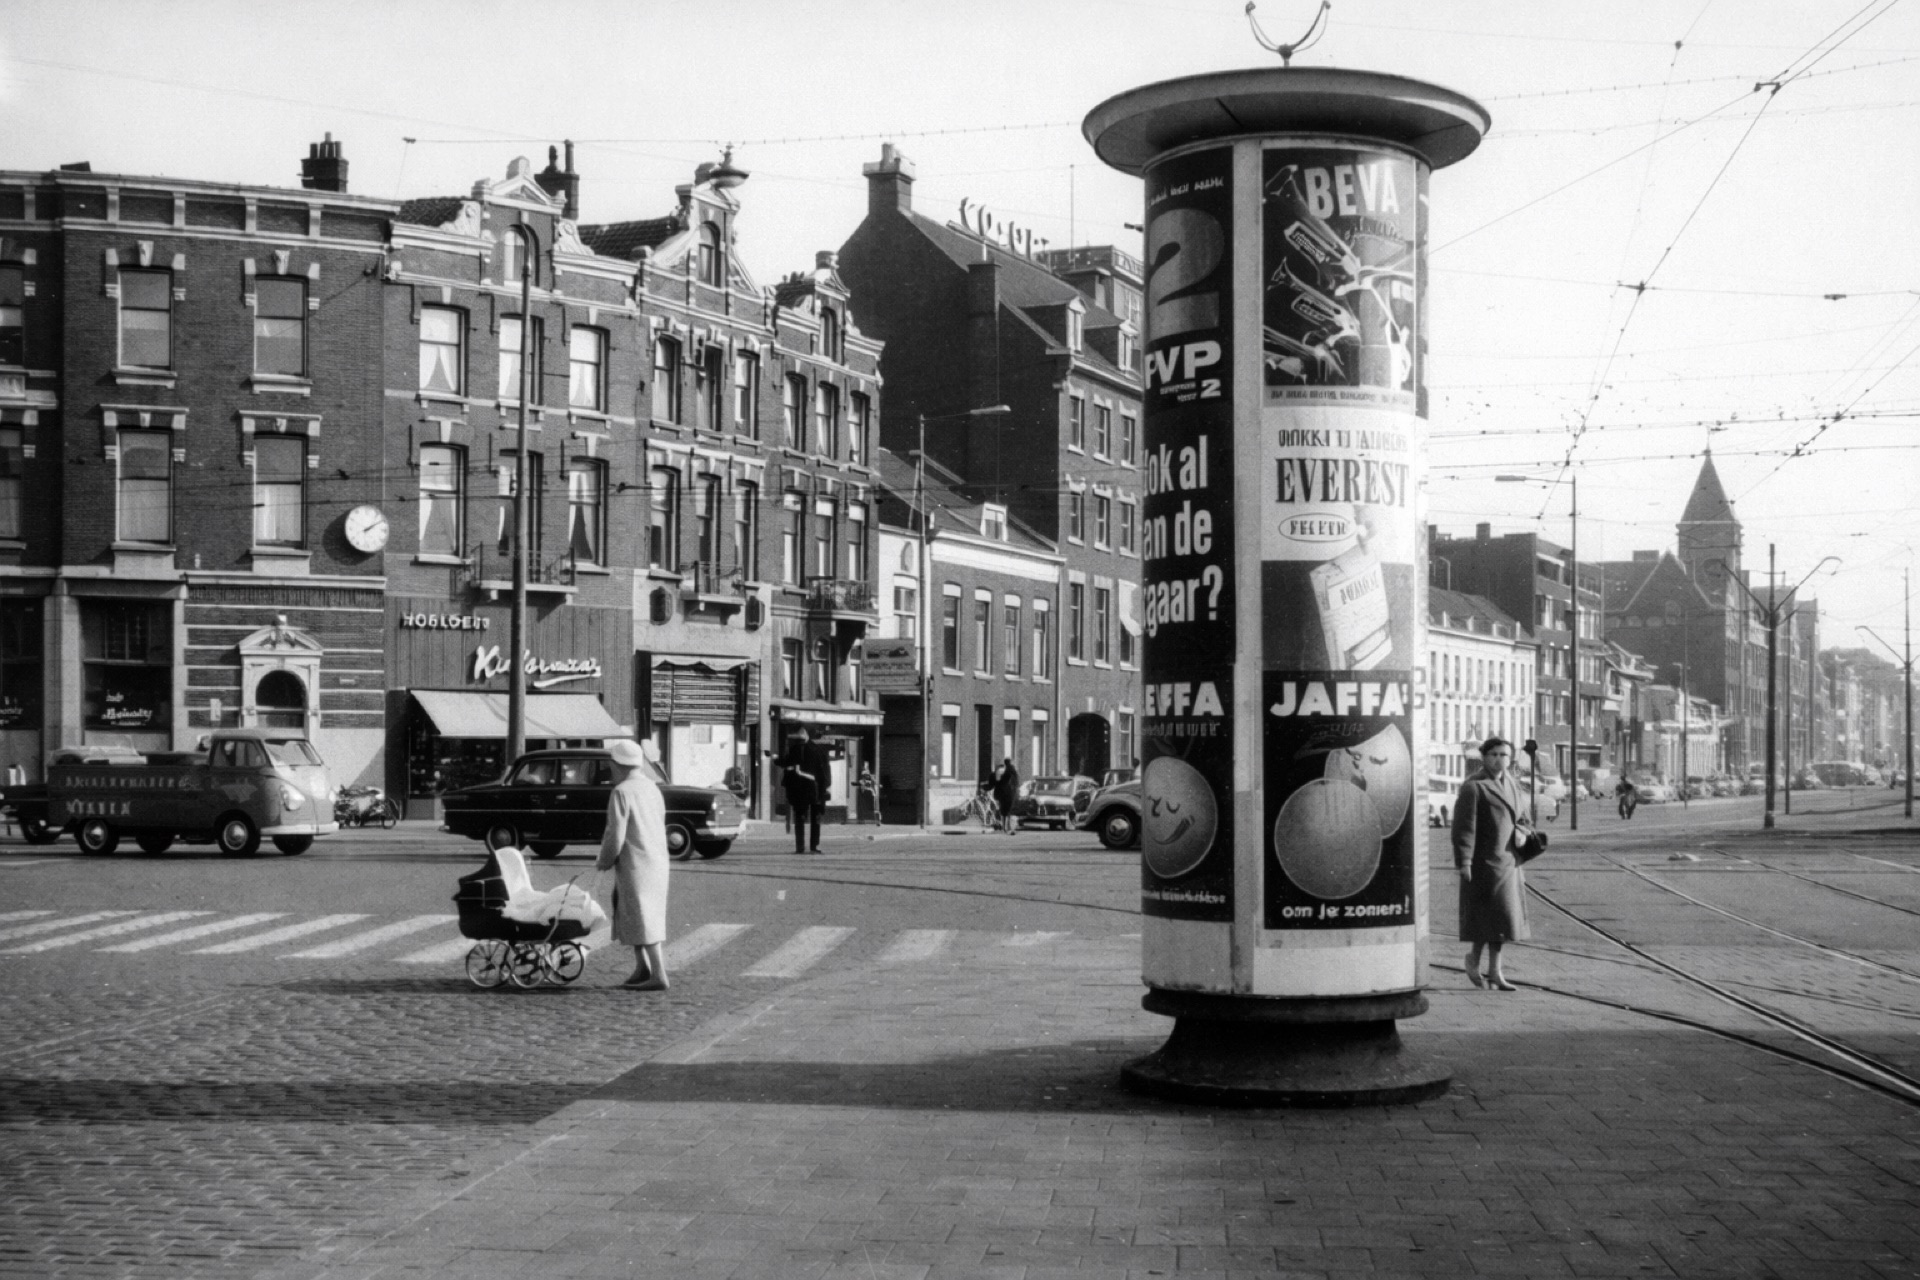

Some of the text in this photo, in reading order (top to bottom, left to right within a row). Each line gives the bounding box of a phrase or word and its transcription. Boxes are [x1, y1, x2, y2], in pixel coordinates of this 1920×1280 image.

[1179, 434, 1209, 491] al
[1275, 457, 1410, 508] EVEREST
[1174, 499, 1213, 557] de
[1144, 564, 1224, 639] gaar?
[1282, 905, 1314, 919] om
